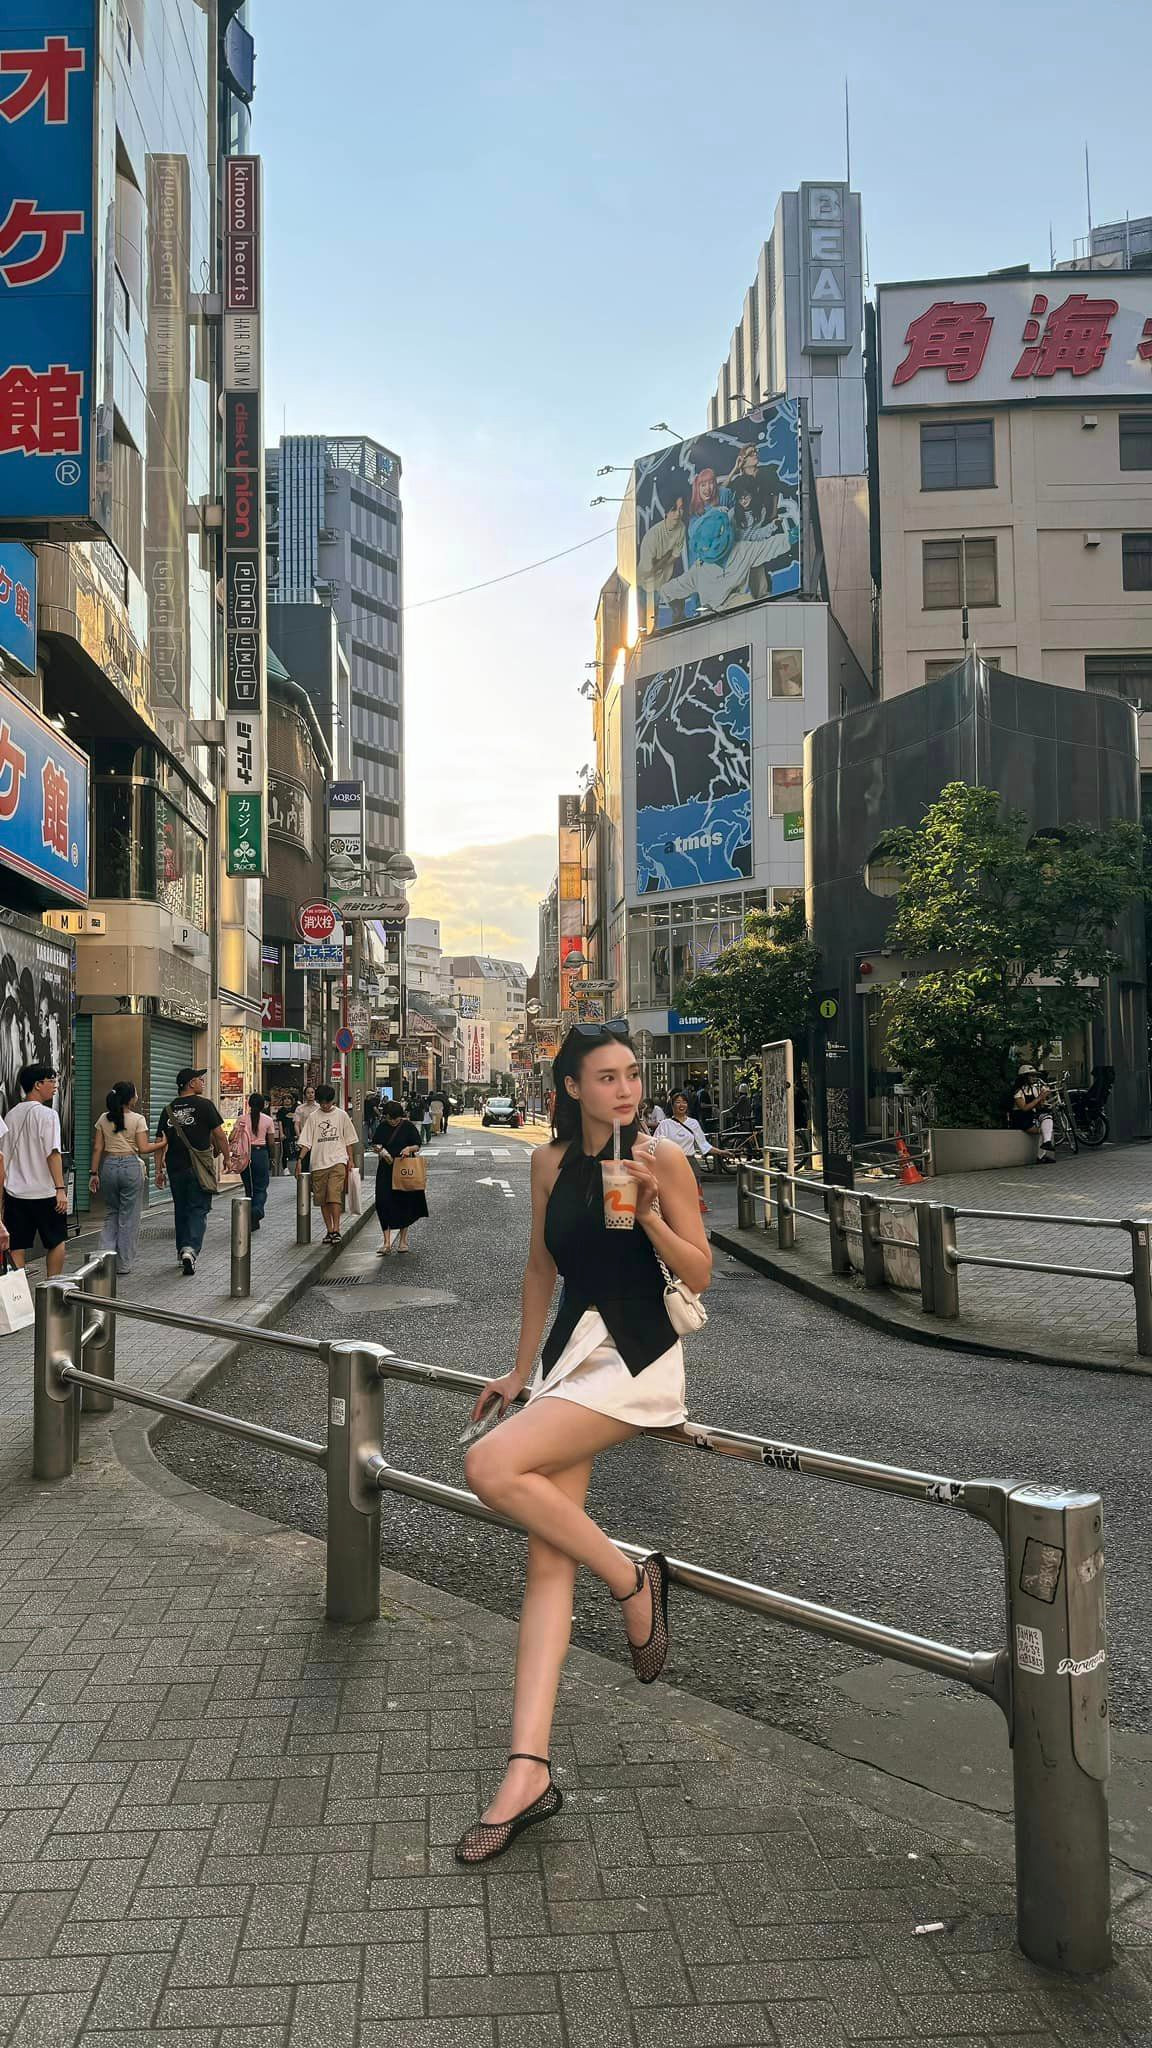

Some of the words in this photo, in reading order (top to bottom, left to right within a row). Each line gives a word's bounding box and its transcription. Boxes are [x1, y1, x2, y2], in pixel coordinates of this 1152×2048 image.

[235, 167, 248, 229] kimono
[235, 241, 248, 301] hearts
[808, 186, 844, 342] BEAM
[234, 318, 250, 340] HAIR
[893, 293, 1152, 386] 角海
[234, 344, 250, 373] SALON
[235, 402, 249, 448] disk
[235, 451, 253, 538] union
[241, 568, 250, 624] PUNG
[241, 638, 251, 678] UMU
[333, 793, 360, 803] AQROS
[238, 799, 251, 839] カジノ
[664, 832, 723, 854] atmos
[304, 915, 333, 929] 消火栓
[400, 1168, 414, 1176] GU
